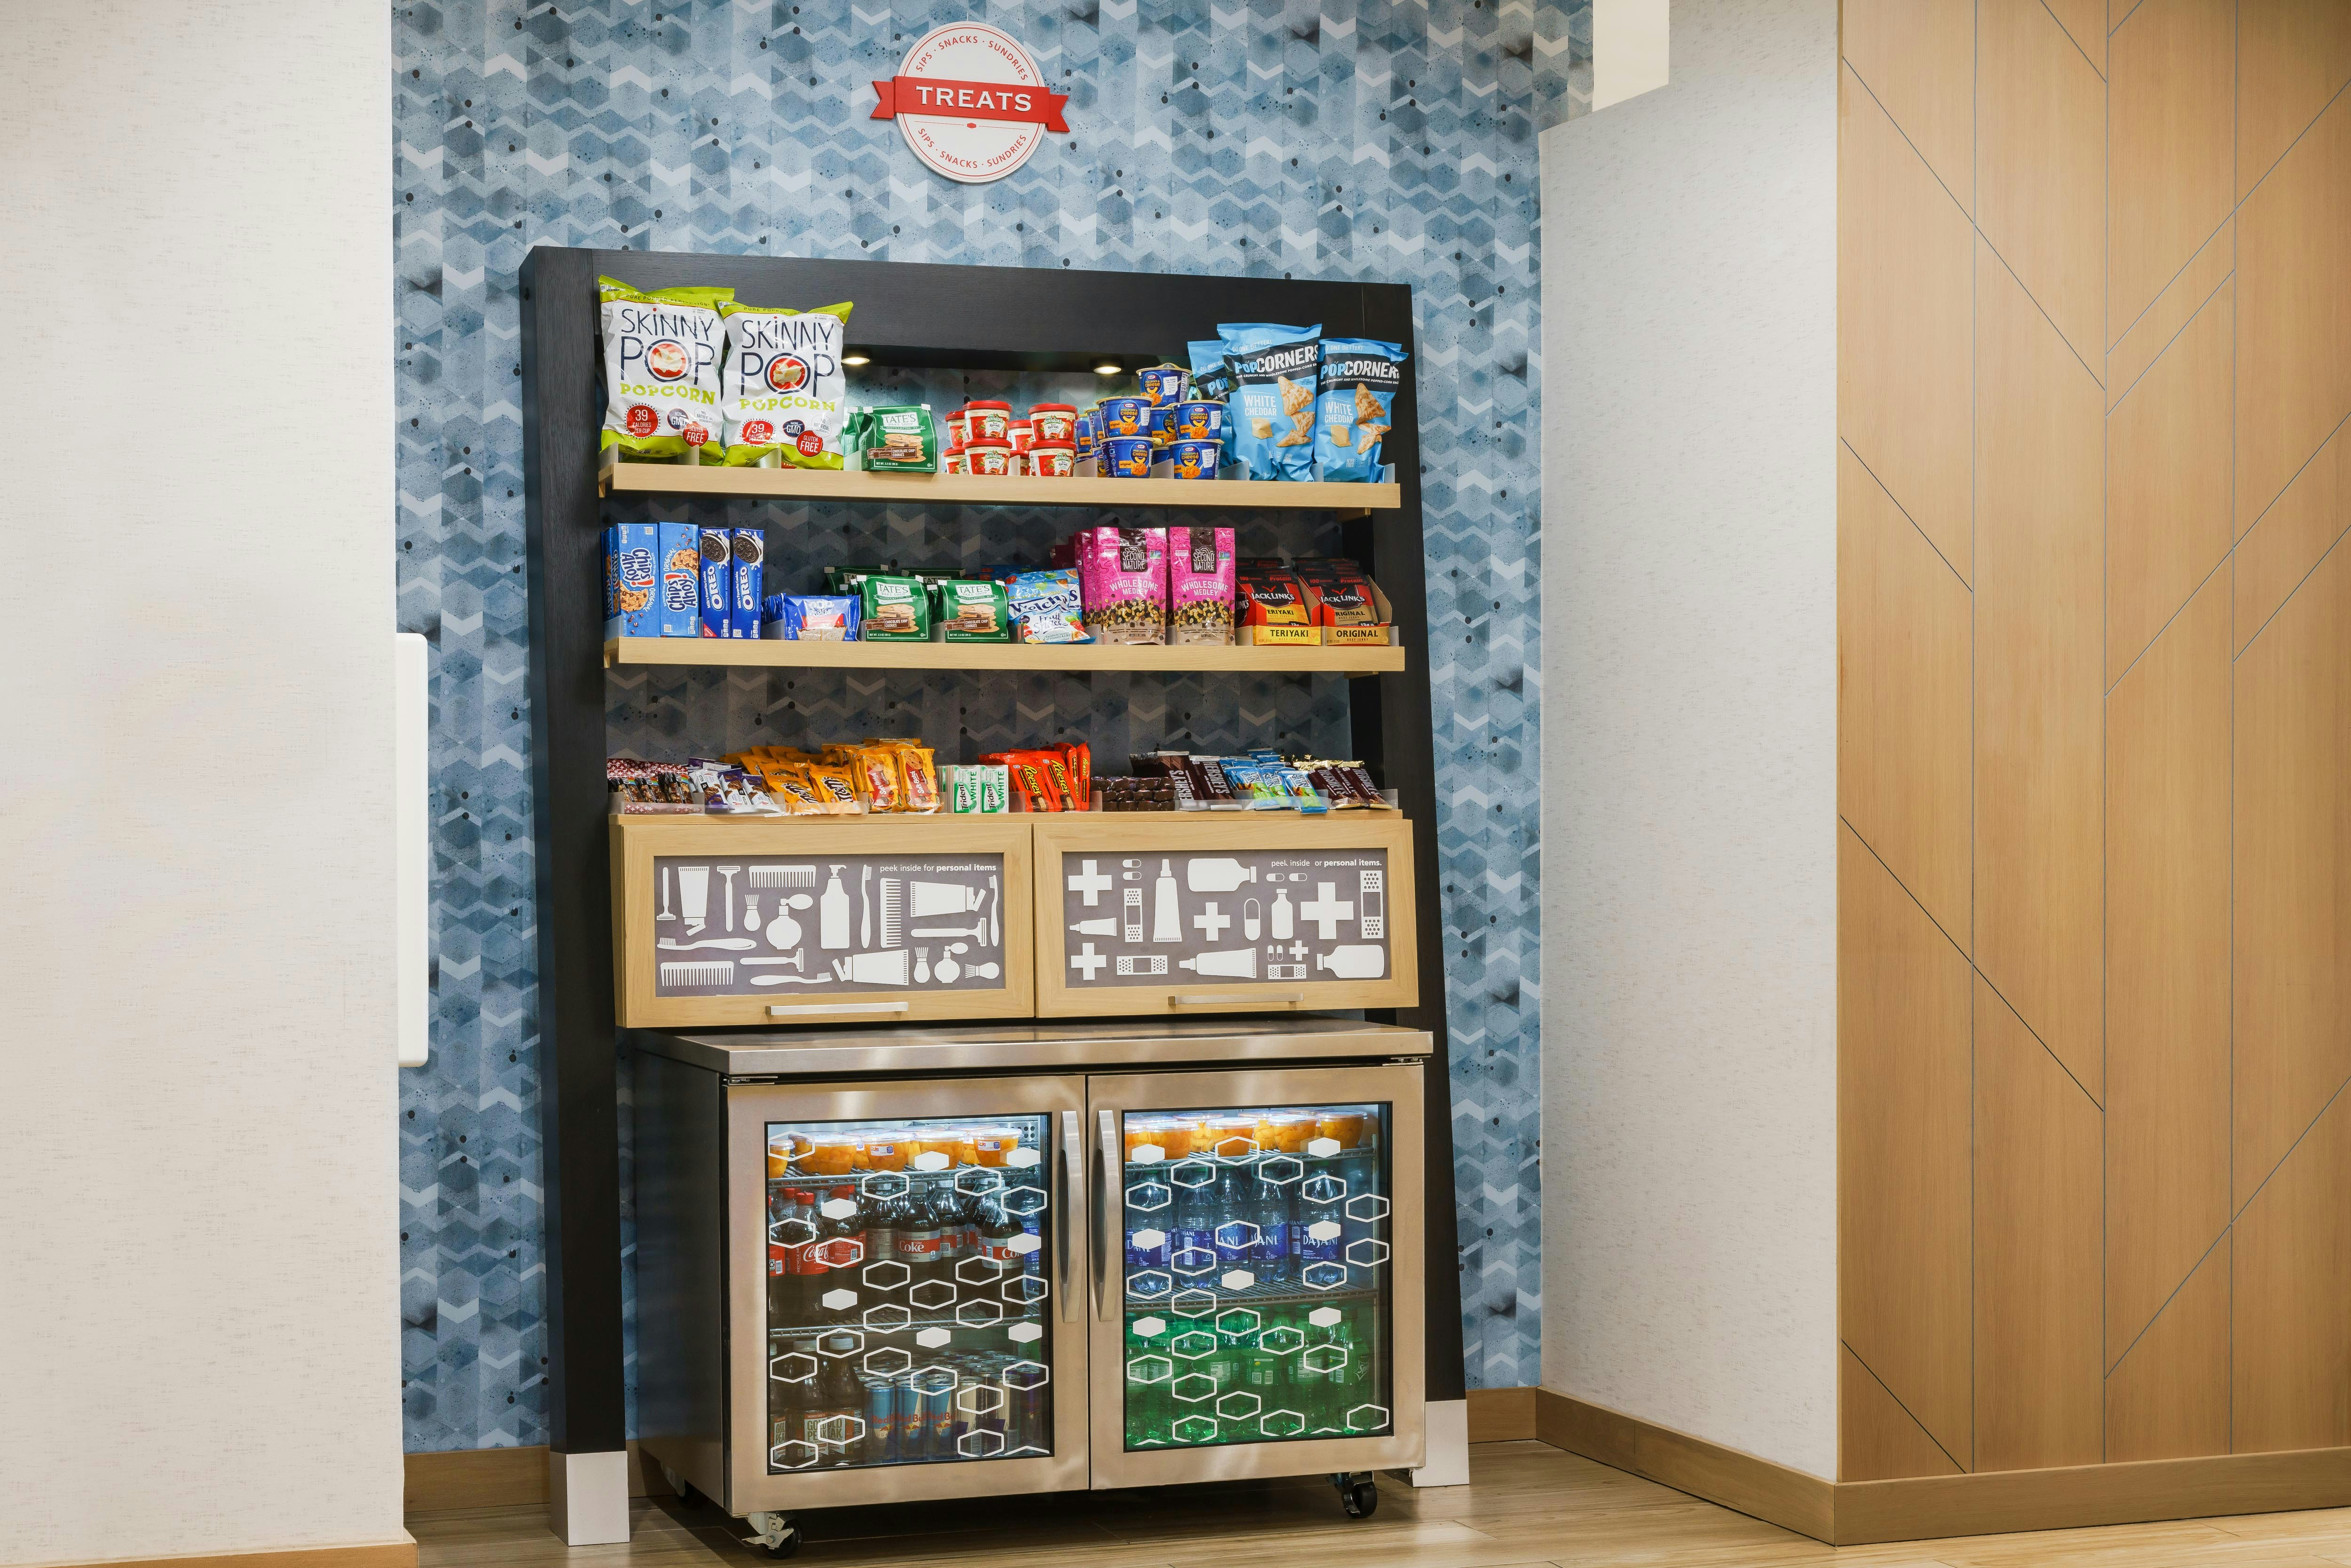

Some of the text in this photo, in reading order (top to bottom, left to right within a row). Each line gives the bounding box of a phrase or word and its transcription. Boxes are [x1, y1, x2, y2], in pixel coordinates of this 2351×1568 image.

[916, 36, 1028, 80] SIPS SNACKS SUNDRIES
[916, 86, 1031, 112] TREATS
[918, 127, 1026, 168] SIPS SNACKS SUNDRIES
[621, 308, 714, 341] SKINNY
[742, 316, 834, 351] SKINNY
[1251, 339, 1272, 349] BETTER!
[621, 336, 715, 385] POP
[1235, 345, 1318, 374] POPCORNERS
[1287, 364, 1312, 372] POPPED-CORN
[741, 352, 835, 398] POP
[620, 383, 716, 405] POPCORN
[739, 396, 836, 412] POPCORN
[1244, 394, 1276, 408] WHITE
[635, 410, 648, 421] 39
[1245, 407, 1277, 416] CHEDDAR
[1325, 402, 1353, 416] WHITE
[884, 414, 916, 423] TATE'S
[1325, 414, 1353, 424] CHEDDAR
[752, 424, 765, 433] 39
[786, 425, 801, 434] GMO
[686, 432, 705, 443] FREE
[800, 441, 818, 453] FREE
[663, 547, 676, 571] ORIGINAL
[1122, 550, 1144, 560] SECOND
[1193, 551, 1215, 561] SECOND
[632, 549, 651, 580] Chips
[1123, 560, 1145, 569] NATURE
[1194, 562, 1215, 571] NATURE
[708, 566, 723, 610] OREO
[740, 566, 754, 610] OREO
[878, 583, 908, 593] TATE'S
[1110, 579, 1158, 591] WHOLESOME
[1181, 581, 1228, 592] WHOLESOME
[643, 588, 656, 612] ORIGINAL
[667, 580, 686, 611] Chips
[1039, 613, 1060, 622] Fruit
[910, 771, 920, 784] Batch
[1022, 764, 1042, 795] Reese's
[1050, 759, 1070, 794] Reese's
[1203, 762, 1230, 794] HERSHEY'S
[958, 783, 969, 811] Trident
[986, 783, 996, 811] Trident
[937, 864, 971, 873] personal
[900, 1241, 924, 1253] Coke
[872, 1414, 890, 1424] Red
[913, 1414, 927, 1422] Bull
[807, 1430, 828, 1441] PEAK
